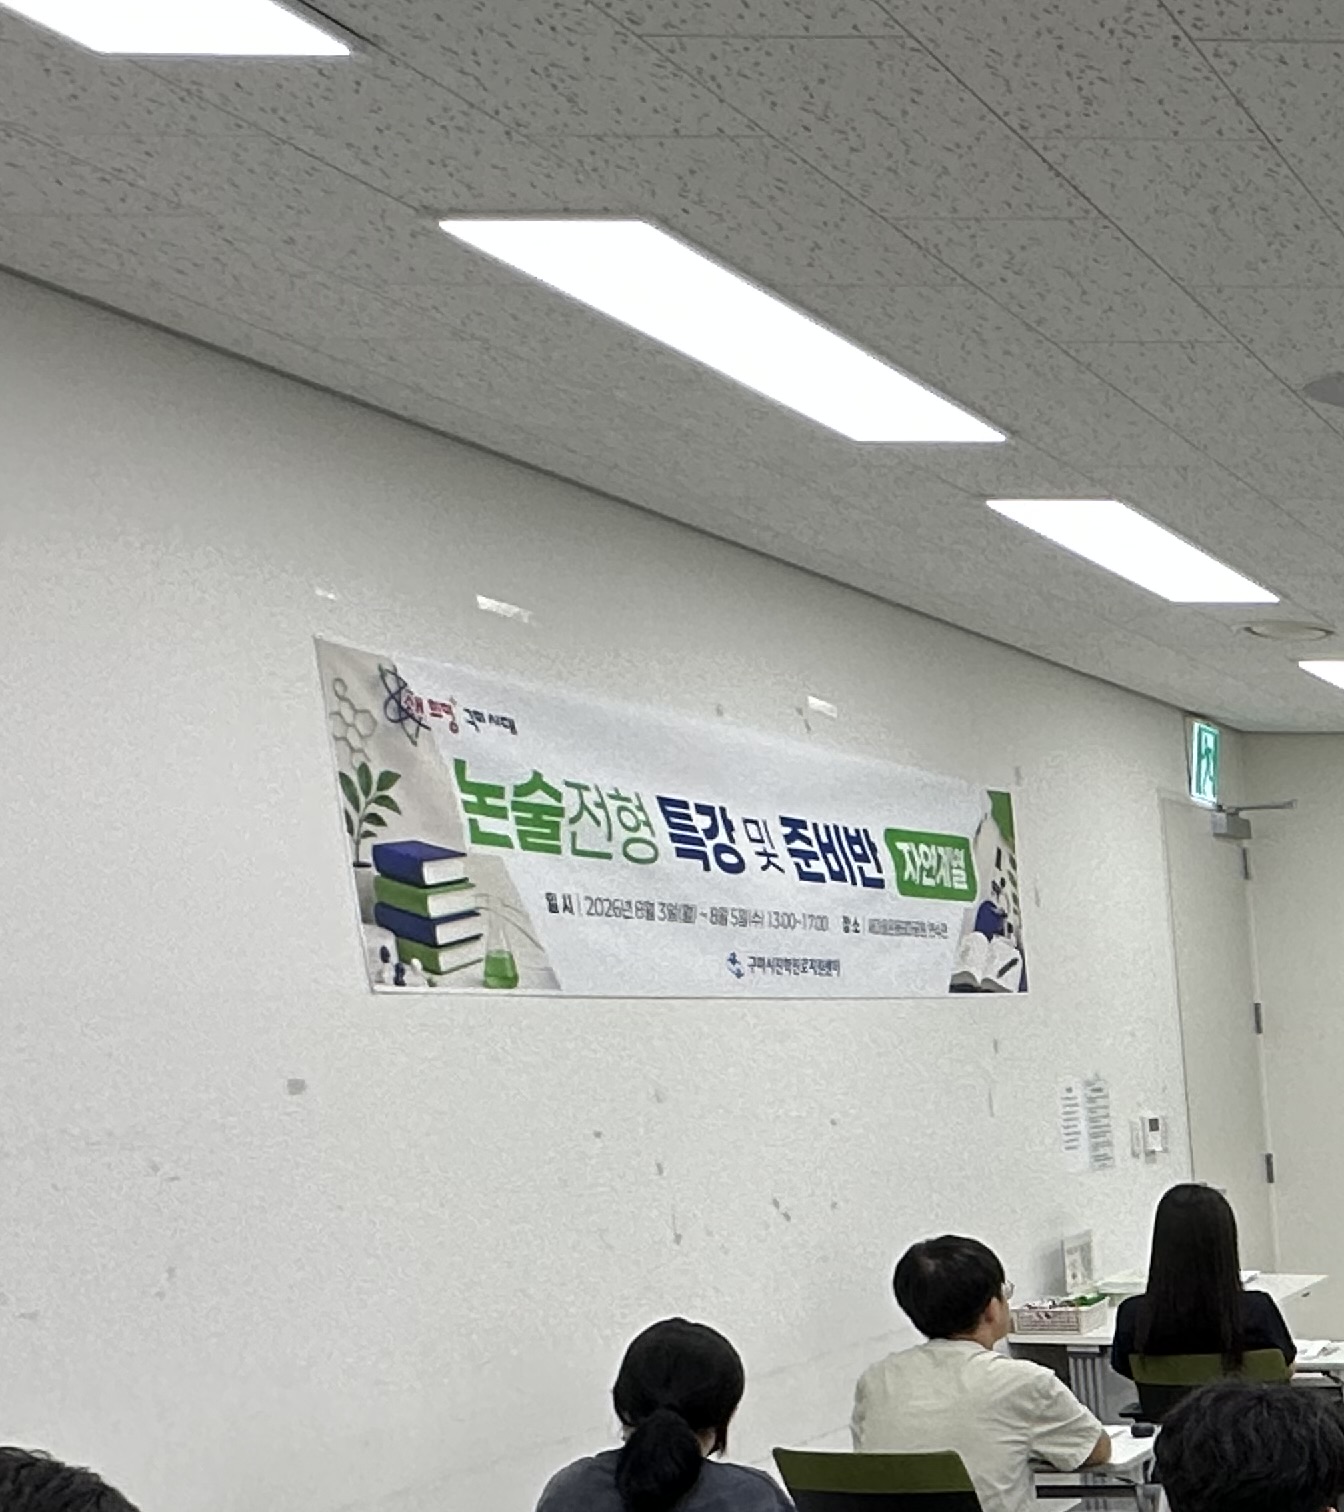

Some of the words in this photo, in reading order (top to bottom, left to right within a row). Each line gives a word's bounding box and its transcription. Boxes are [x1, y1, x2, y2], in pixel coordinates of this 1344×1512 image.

[454, 758, 660, 865] 논술전형
[656, 795, 746, 874] 특강
[741, 817, 785, 874] 및
[779, 815, 886, 889] 준비반
[895, 841, 969, 891] 자연계열
